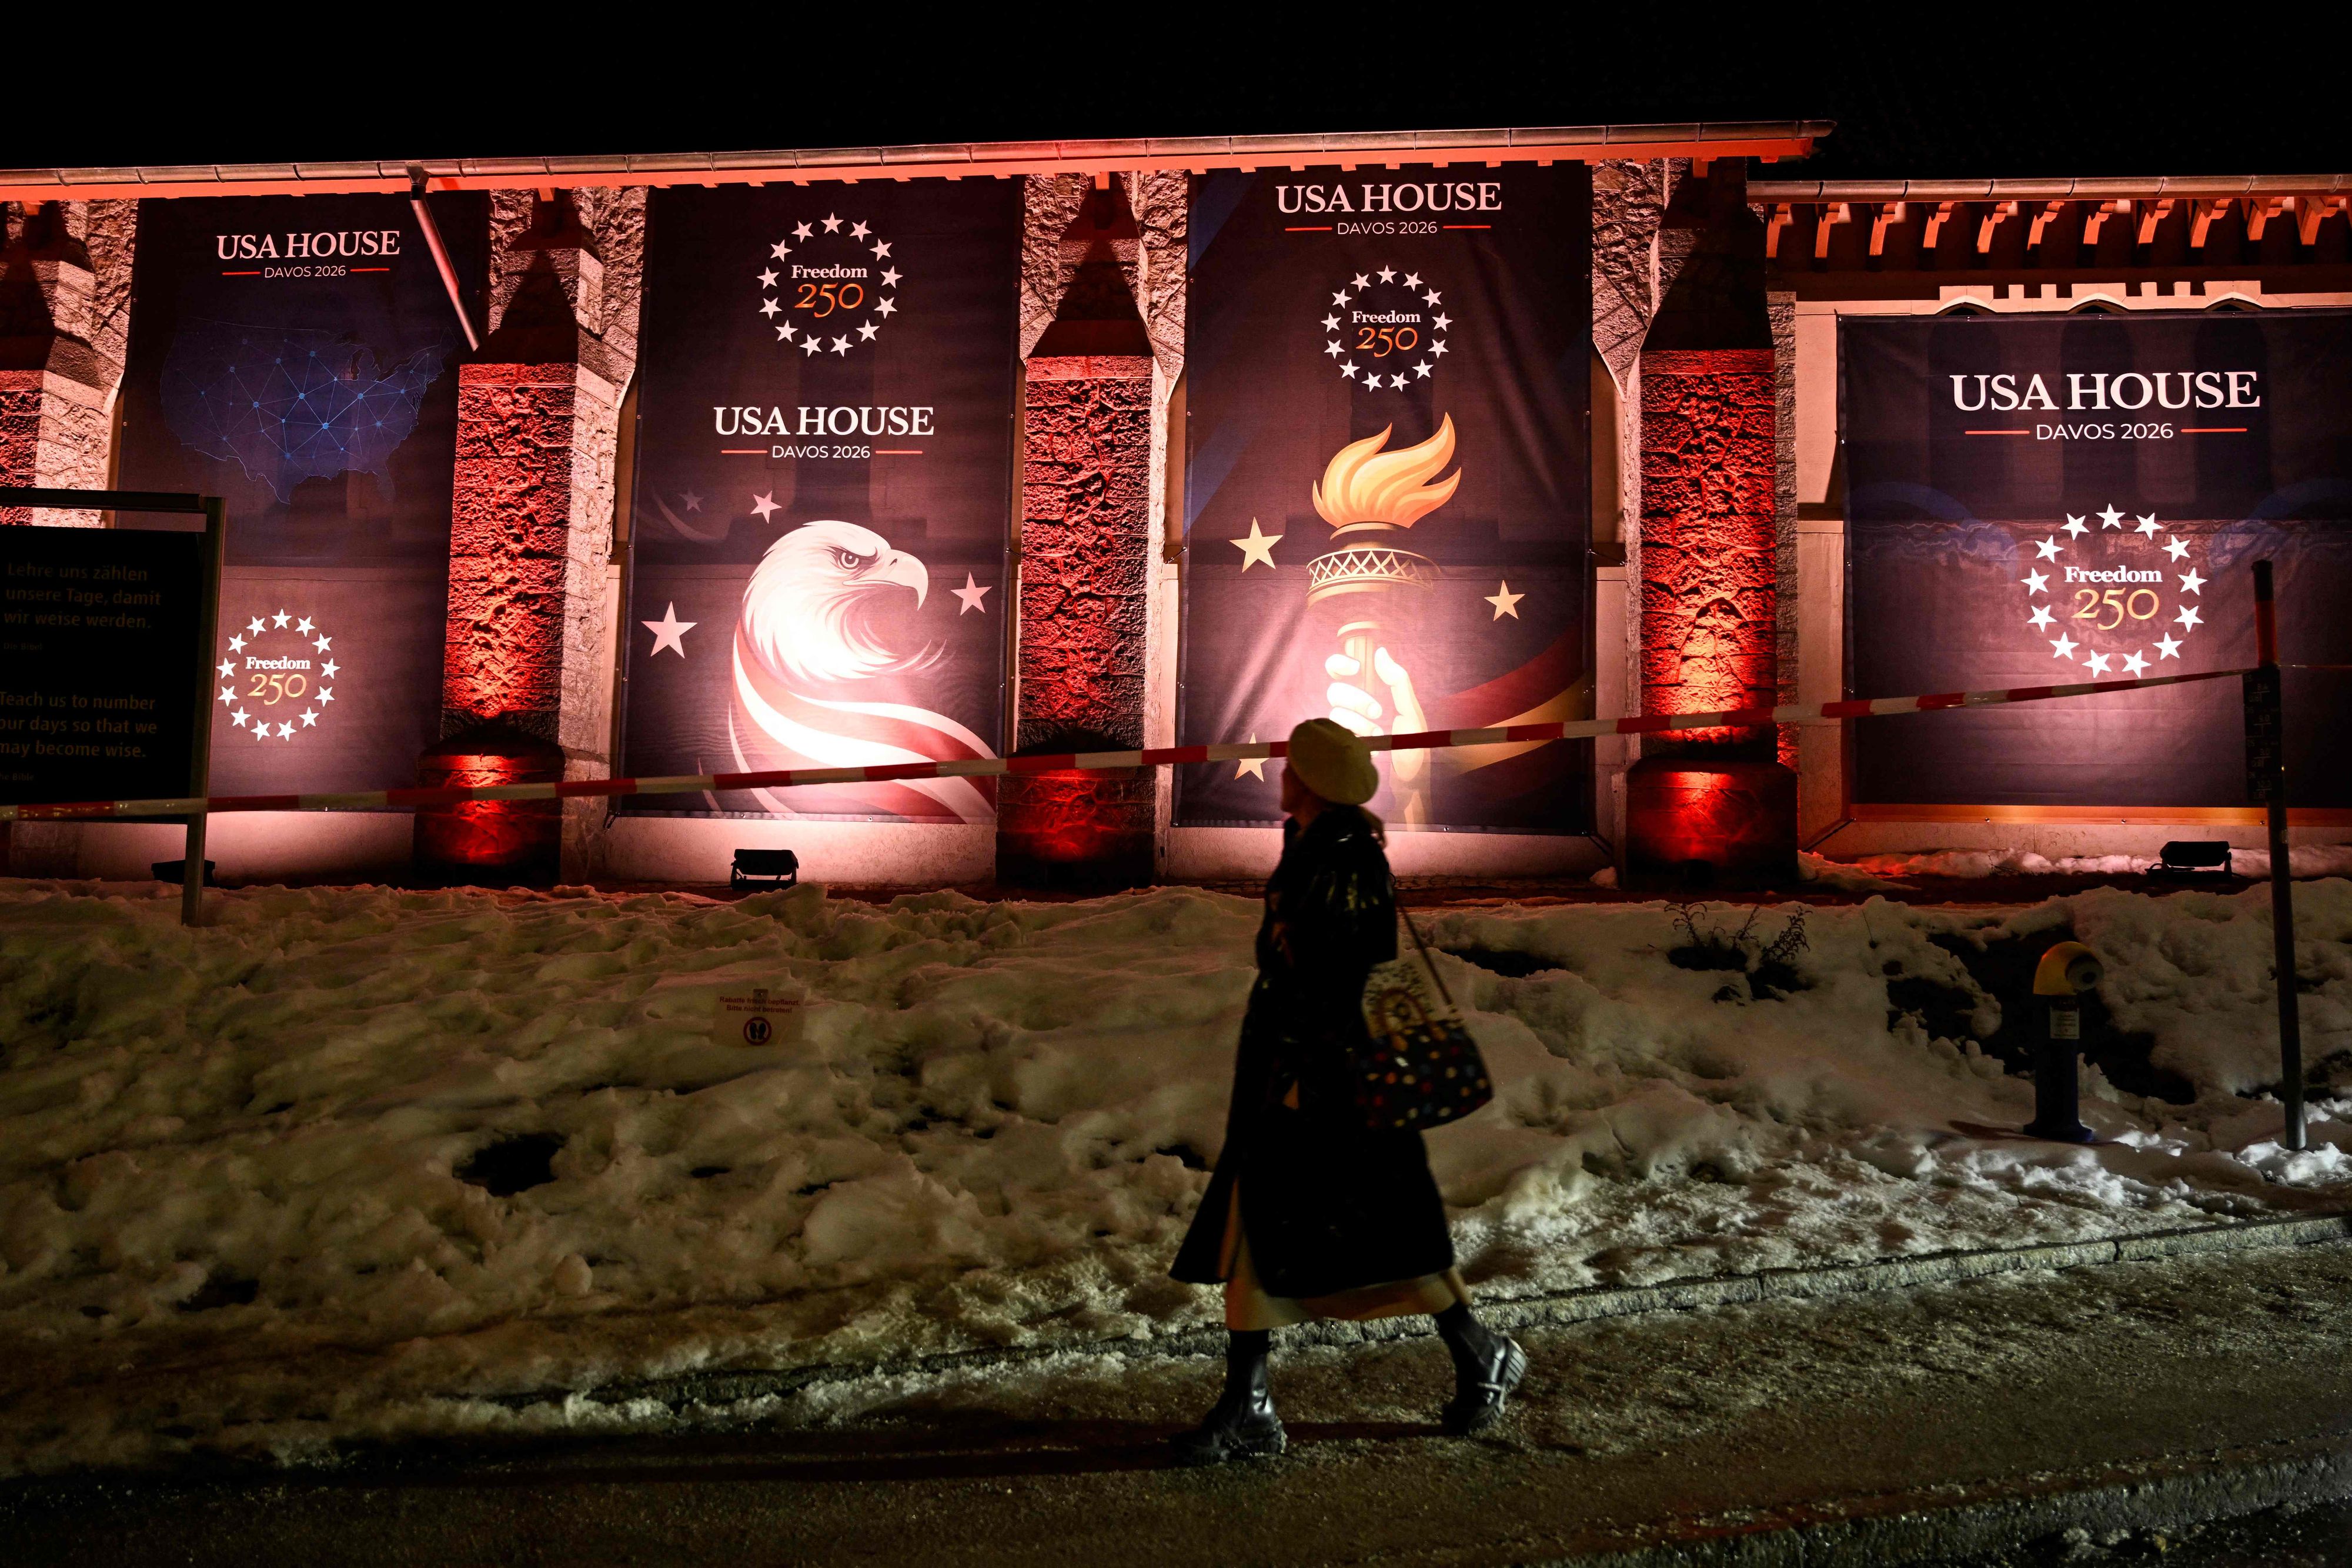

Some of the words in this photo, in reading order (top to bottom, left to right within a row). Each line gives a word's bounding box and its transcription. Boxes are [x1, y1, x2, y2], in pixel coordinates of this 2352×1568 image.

[1275, 184, 1355, 213] USA
[1361, 182, 1502, 212] HOUSE
[1337, 222, 1395, 235] DAVOS
[1399, 221, 1438, 234] 2026
[216, 234, 280, 260] USA
[285, 230, 400, 258] HOUSE
[265, 266, 311, 278] DAVOS
[315, 265, 346, 277] 2026
[791, 263, 868, 279] Freedom
[794, 282, 864, 318] 250
[1351, 310, 1421, 323] Freedom
[1355, 326, 1418, 357] 250
[1949, 373, 2060, 411] USA
[2066, 371, 2260, 410] HOUSE
[713, 406, 791, 436] USA
[796, 406, 935, 436] HOUSE
[2036, 423, 2115, 440] DAVOS
[2120, 423, 2174, 439] 2026
[772, 445, 829, 459] DAVOS
[832, 445, 871, 459] 2026
[7, 563, 53, 577] Lehre
[59, 567, 88, 579] uns
[93, 564, 148, 581] zählen
[2064, 565, 2163, 583] Freedom
[6, 589, 61, 601] unsere
[66, 588, 109, 606] Tage,
[113, 589, 161, 606] damit
[2071, 587, 2160, 631] 250
[4, 610, 29, 624] wir
[35, 611, 81, 626] weise
[85, 613, 151, 628] werden.
[245, 656, 311, 670] Freedom
[247, 673, 307, 706] 250
[0, 691, 42, 706] Teach
[49, 697, 66, 707] us
[72, 694, 88, 708] to
[93, 695, 156, 710] number
[30, 716, 66, 734] days
[72, 721, 91, 733] so
[96, 718, 131, 733] that
[135, 723, 158, 733] we
[35, 740, 100, 756] become
[106, 741, 147, 758] wise.
